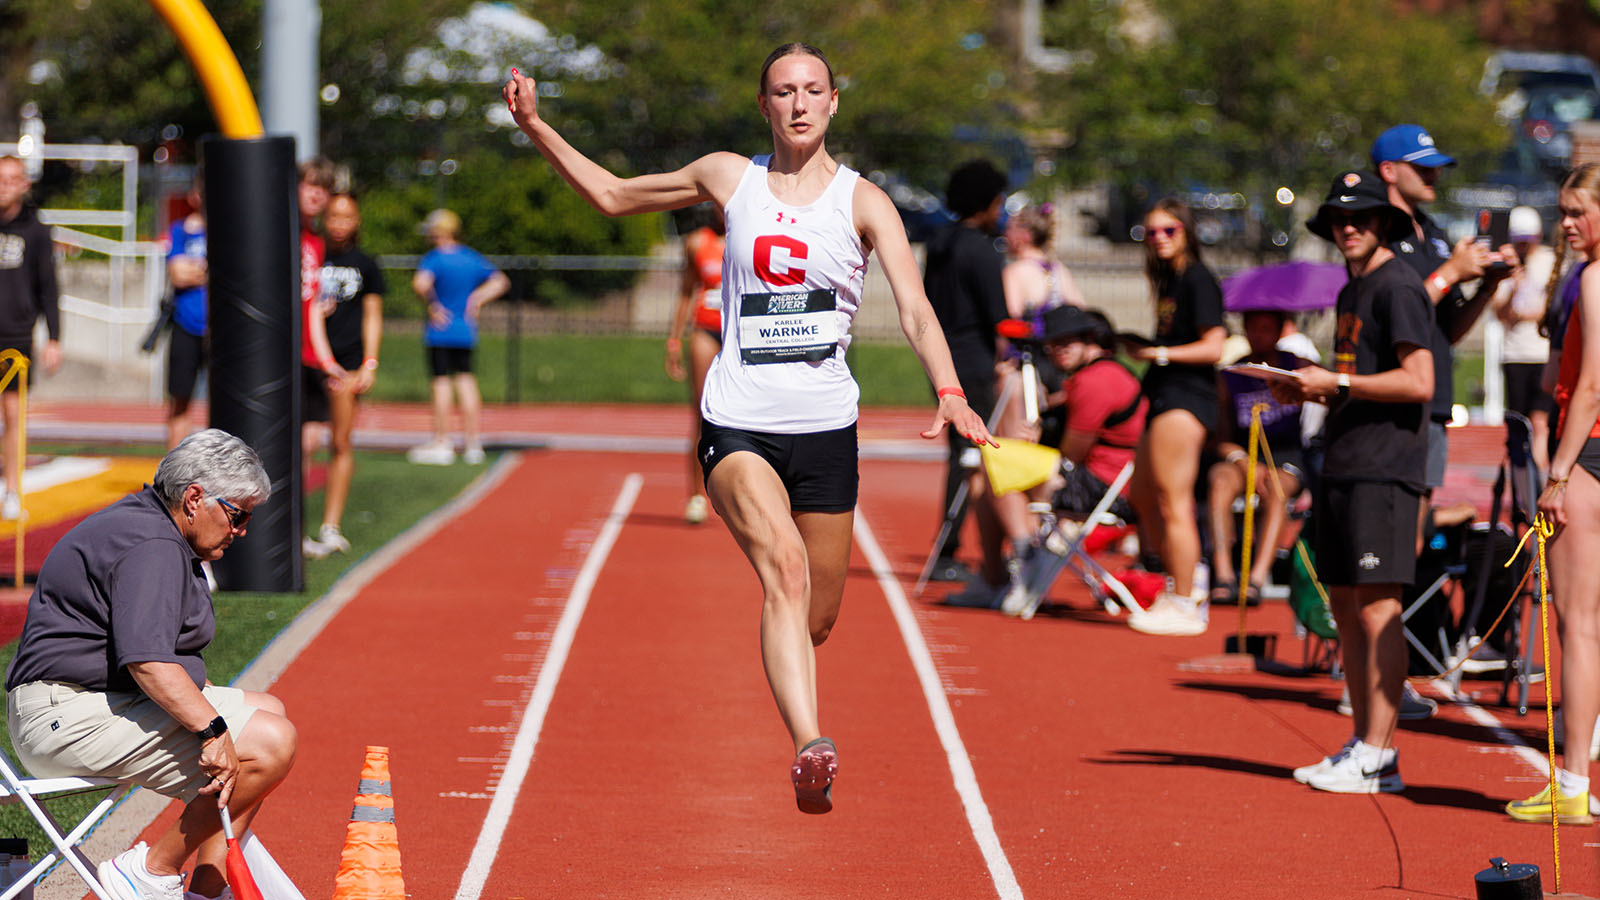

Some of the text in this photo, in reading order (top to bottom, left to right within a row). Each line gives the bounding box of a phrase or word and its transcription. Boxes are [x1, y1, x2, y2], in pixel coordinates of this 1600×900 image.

[753, 234, 808, 287] C
[769, 293, 809, 302] AMERICAN
[767, 300, 807, 314] RIVERS
[759, 325, 819, 338] WARNKE
